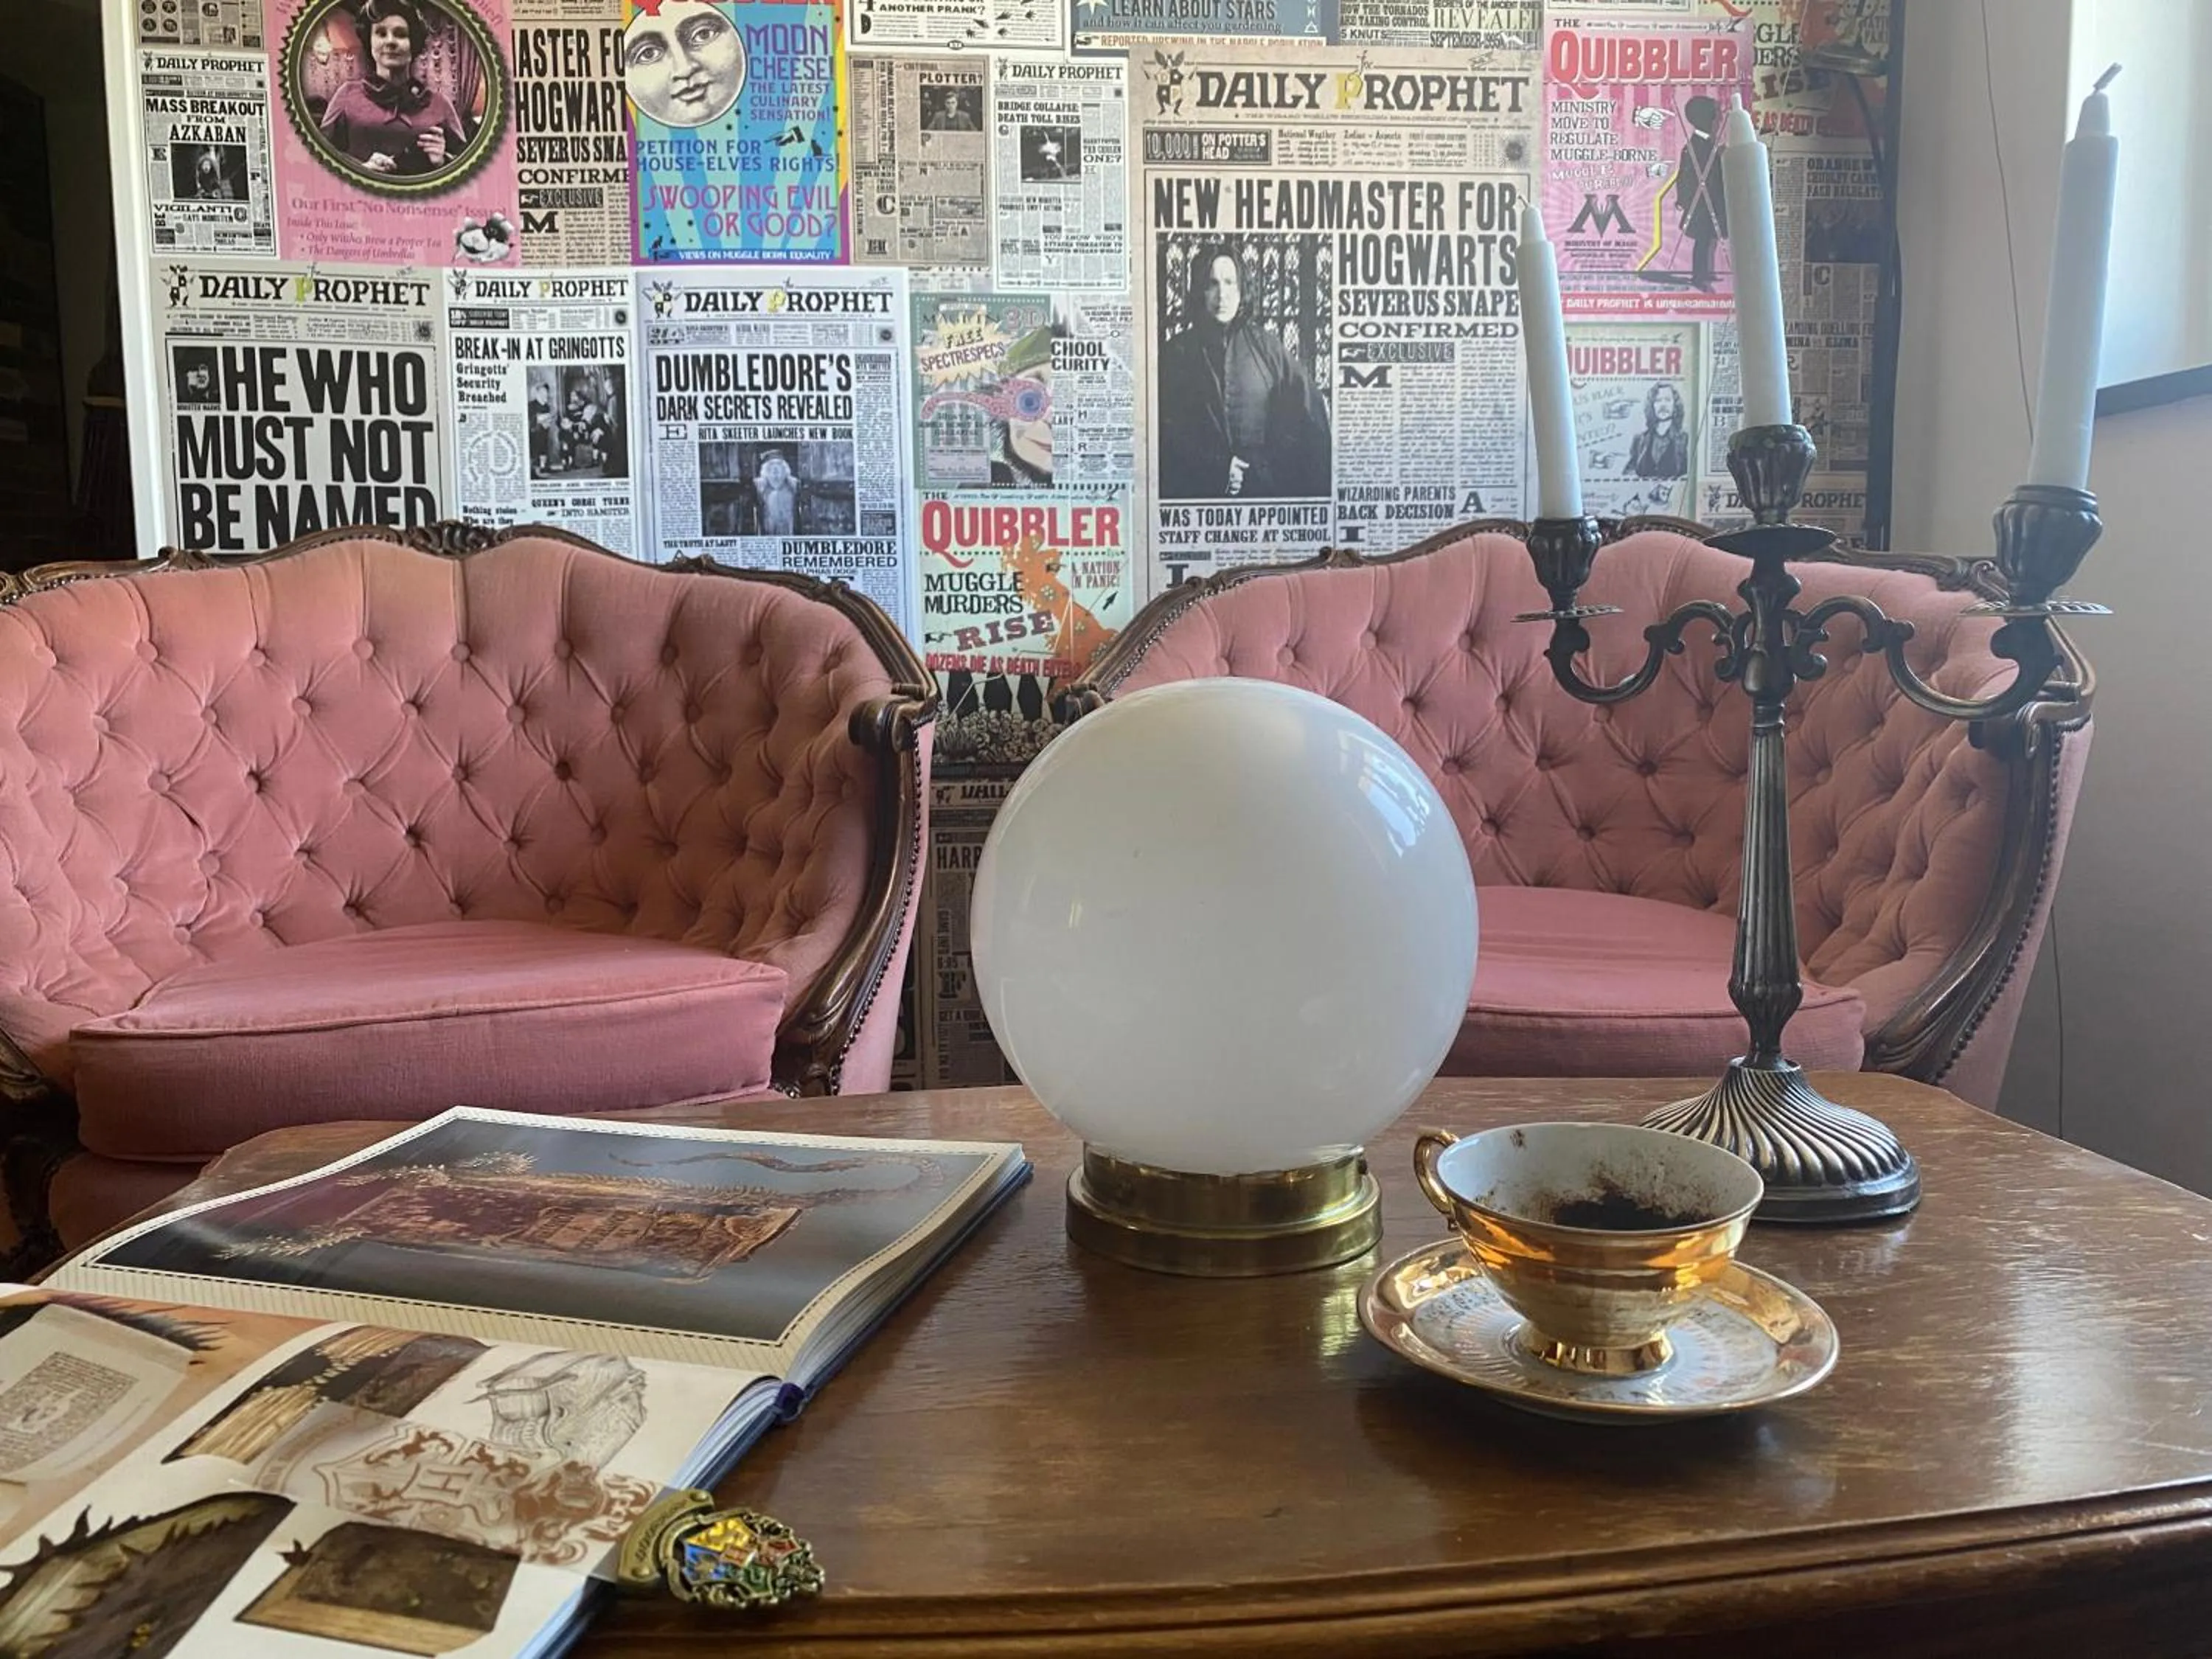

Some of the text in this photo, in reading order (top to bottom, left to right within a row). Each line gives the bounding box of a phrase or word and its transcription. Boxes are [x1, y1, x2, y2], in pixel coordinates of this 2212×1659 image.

[880, 4, 934, 13] ANOTHER
[1113, 0, 1275, 19] LEARN ABOUT STARS
[1555, 19, 1580, 27] THE
[745, 24, 827, 55] MOON
[511, 29, 591, 77] ASTER
[156, 58, 265, 72] DAILY PROPHET
[749, 56, 834, 80] CHEESE!
[1012, 65, 1123, 80] DAILY PROPHET
[1551, 30, 1738, 99] QUIBBLER
[919, 73, 983, 85] PLOTTER?
[749, 83, 830, 94] THE LATEST
[1196, 72, 1529, 112] DAILY PROPHET
[146, 98, 265, 116] MASS BREAKOUT
[514, 81, 627, 133] HOGWART
[751, 96, 818, 107] CULINARY
[998, 102, 1031, 111] BRIDGE
[1551, 101, 1616, 114] MINISTRY
[187, 115, 226, 123] FROM
[751, 107, 831, 121] SENSATION!
[998, 113, 1028, 122] DEATH
[1031, 114, 1052, 123] TOLL
[1551, 117, 1610, 130] MOVE TO
[170, 124, 246, 142] AZKABAN
[1202, 134, 1215, 145] ON
[1219, 133, 1267, 147] POTTER'S
[1550, 133, 1618, 145] REGULATE
[517, 136, 590, 163] SEVERUS
[636, 140, 761, 155] PETITION FOR
[1202, 147, 1230, 160] HEAD
[636, 153, 841, 173] HOUSE-ELVES RIGHTS!
[1083, 155, 1121, 163] ONE?
[643, 185, 838, 211] SWOOPING EVIL
[1155, 178, 1517, 231] NEW HEADMASTER FOR
[520, 212, 559, 233] M
[704, 212, 838, 237] OR GOOD?
[1339, 234, 1517, 286] HOGWARTS
[199, 275, 430, 306] DAILY PROPHET
[476, 279, 628, 297] DAILY PROPHET
[684, 289, 894, 313] DAILY PROPHET
[1338, 289, 1519, 316] SEVERUS SNAPE
[1338, 321, 1519, 338] CONFIRMED
[455, 336, 521, 360] BREAK-IN
[526, 337, 543, 360] AT
[549, 335, 625, 359] GRINGOTTS
[920, 341, 1006, 372] SPECTRESPECS
[222, 347, 428, 416] HE WHO
[655, 354, 852, 392] DUMBLEDORE'S
[1338, 366, 1392, 388] M
[456, 377, 501, 390] Security
[458, 391, 507, 403] Breached
[656, 395, 853, 421] DARK SECRETS REVEALED
[698, 427, 718, 439] RITA
[722, 427, 758, 439] SKEETER
[762, 427, 804, 439] LAUNCHES
[810, 427, 827, 439] NEW
[177, 416, 434, 484] MUST NOT
[923, 492, 948, 500] THE
[1337, 486, 1455, 502] WIZARDING PARENTS
[180, 484, 437, 549] BE NAMED
[1159, 507, 1328, 527] WAS TODAY APPOINTED
[1338, 504, 1455, 520] BACK DECISION
[922, 501, 1120, 568] QUIBBLER
[1159, 529, 1331, 544] STAFF CHANGE AT SCHOOL
[782, 541, 897, 554] DUMBLEDORE
[782, 557, 897, 567] REMEMBERED
[925, 571, 1024, 592] MUGGLE
[925, 594, 1023, 614] MURDERS
[953, 610, 1054, 651] RISE
